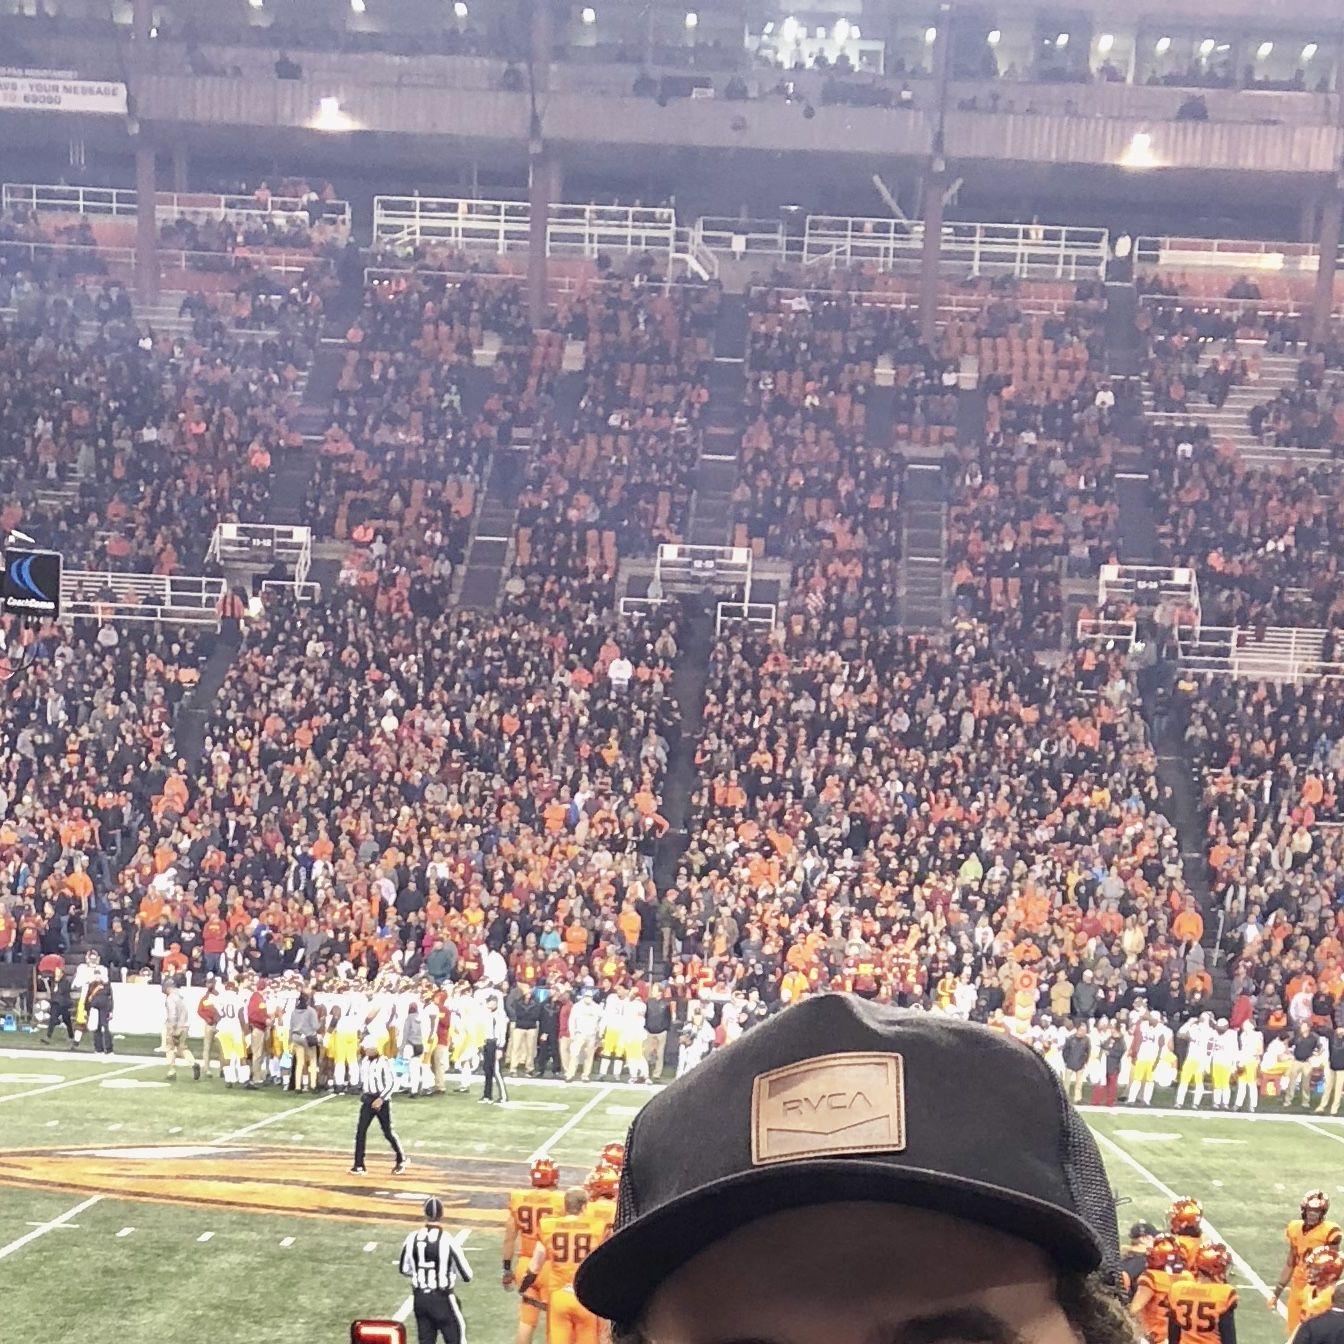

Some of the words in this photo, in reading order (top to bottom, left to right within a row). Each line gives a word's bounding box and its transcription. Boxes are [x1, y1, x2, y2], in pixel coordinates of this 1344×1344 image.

[783, 1090, 873, 1118] RVCA
[416, 1241, 435, 1269] L
[552, 1231, 591, 1264] 98
[1176, 1299, 1216, 1333] 35
